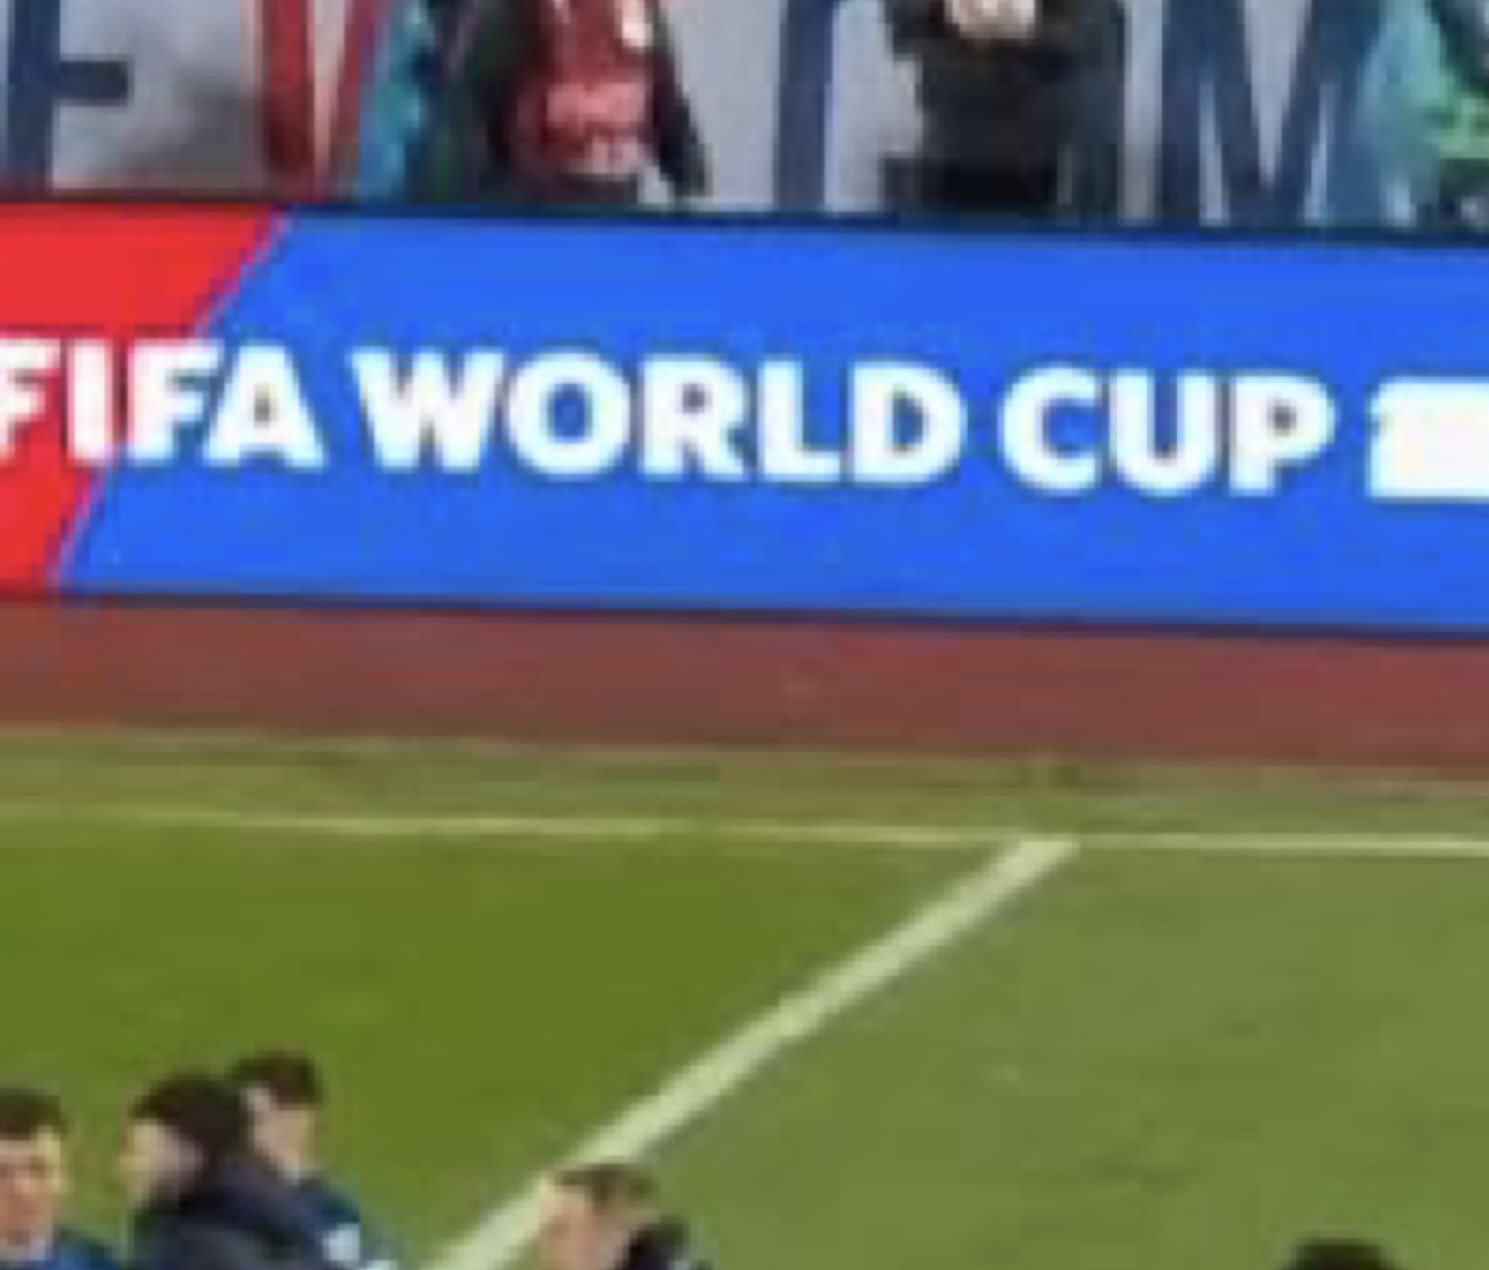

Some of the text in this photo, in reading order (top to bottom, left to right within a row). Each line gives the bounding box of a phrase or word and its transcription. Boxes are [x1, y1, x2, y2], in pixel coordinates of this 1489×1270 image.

[0, 337, 326, 469] FIFA
[350, 346, 970, 485] WORLD
[998, 365, 1338, 496] CUP
